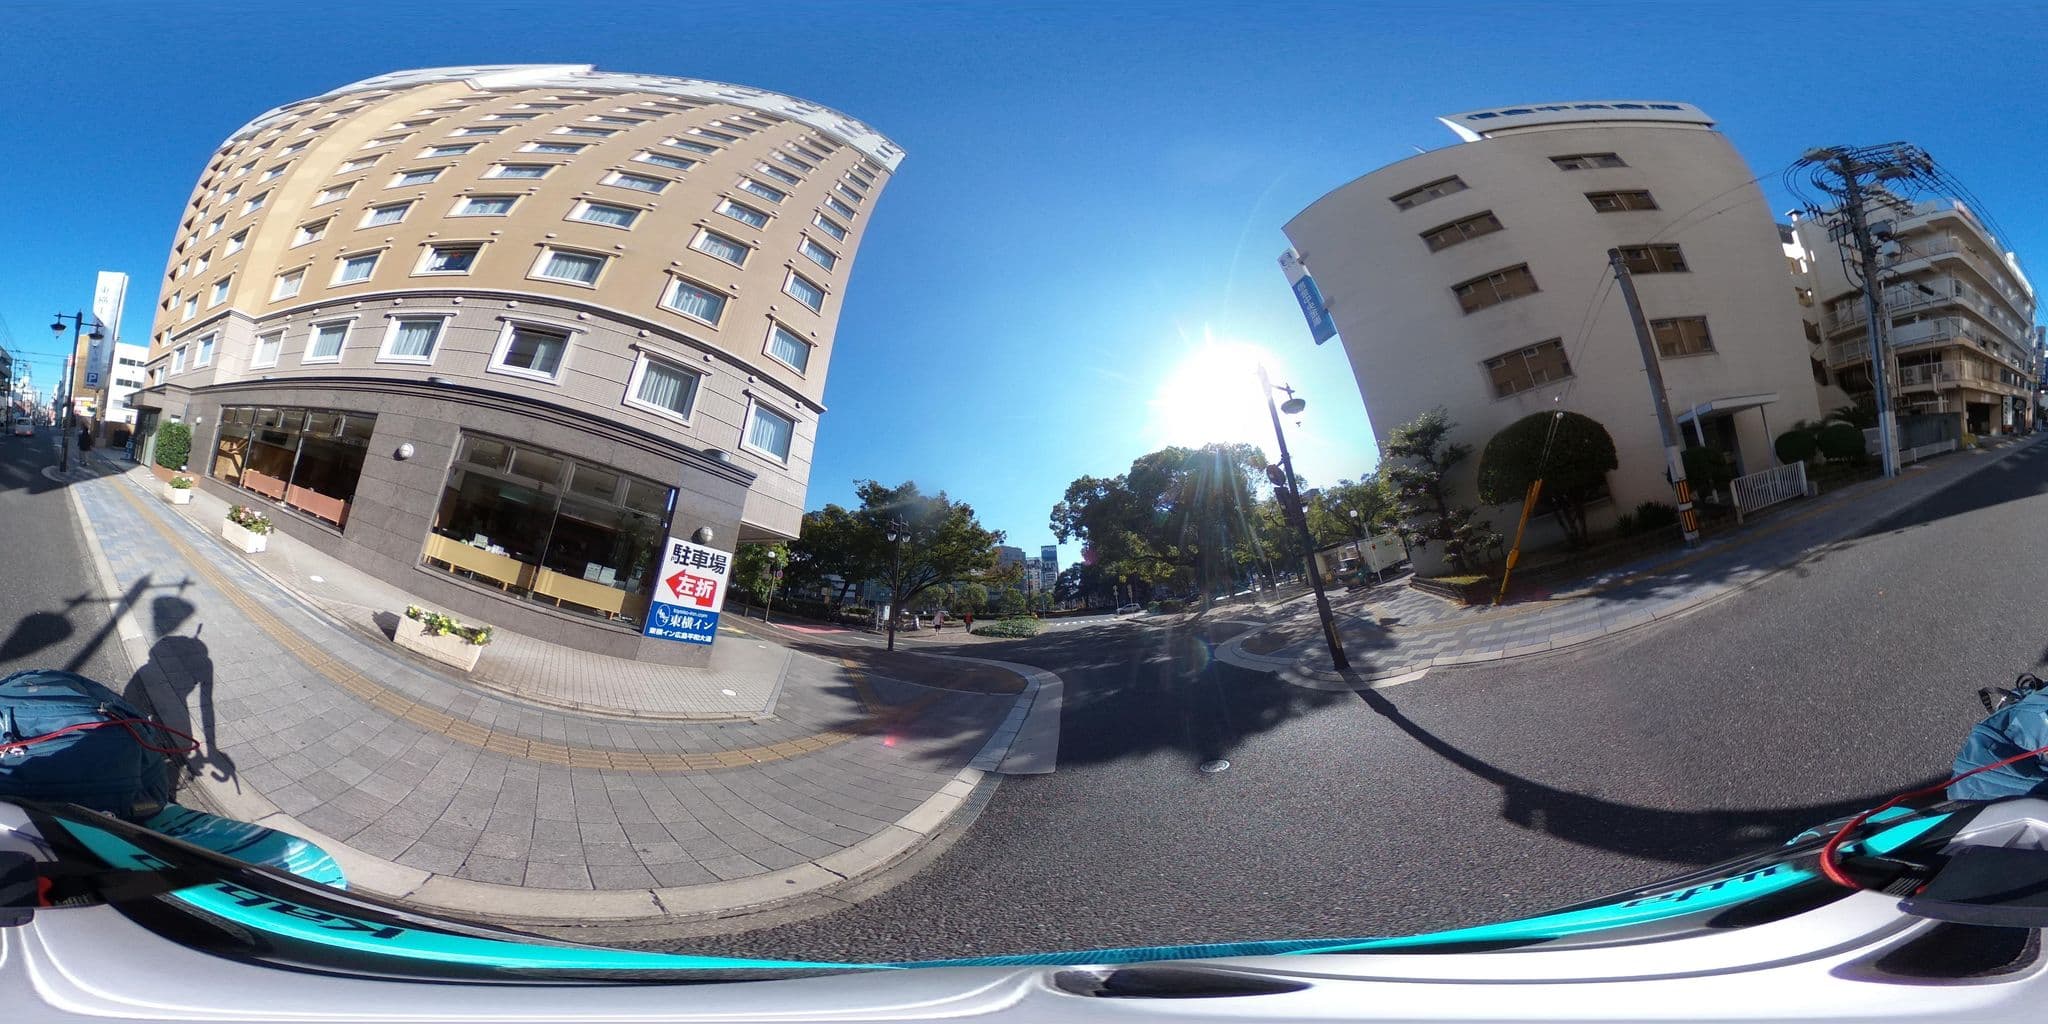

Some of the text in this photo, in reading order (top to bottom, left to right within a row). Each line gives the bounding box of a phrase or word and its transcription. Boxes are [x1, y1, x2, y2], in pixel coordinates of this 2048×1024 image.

[672, 544, 727, 575] 駐車場
[676, 575, 713, 599] 左折
[669, 615, 713, 630] 東横イン
